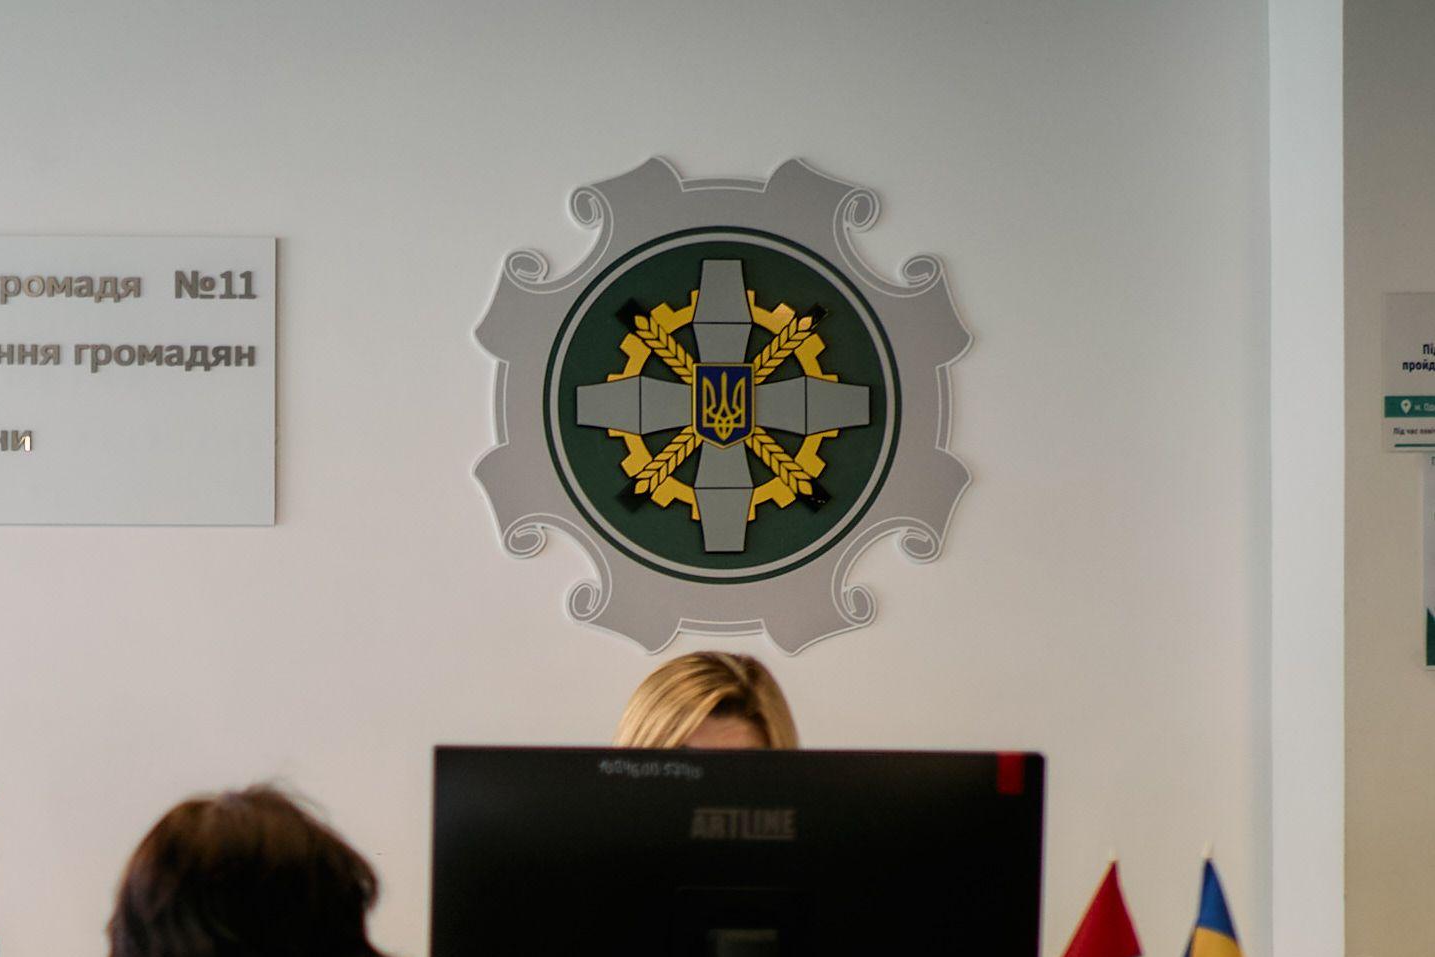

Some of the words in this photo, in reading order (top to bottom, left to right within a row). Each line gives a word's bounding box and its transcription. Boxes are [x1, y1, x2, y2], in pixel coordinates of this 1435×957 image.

[174, 269, 258, 300] №11
[74, 343, 257, 375] громадян
[691, 807, 797, 841] ARTLINE
